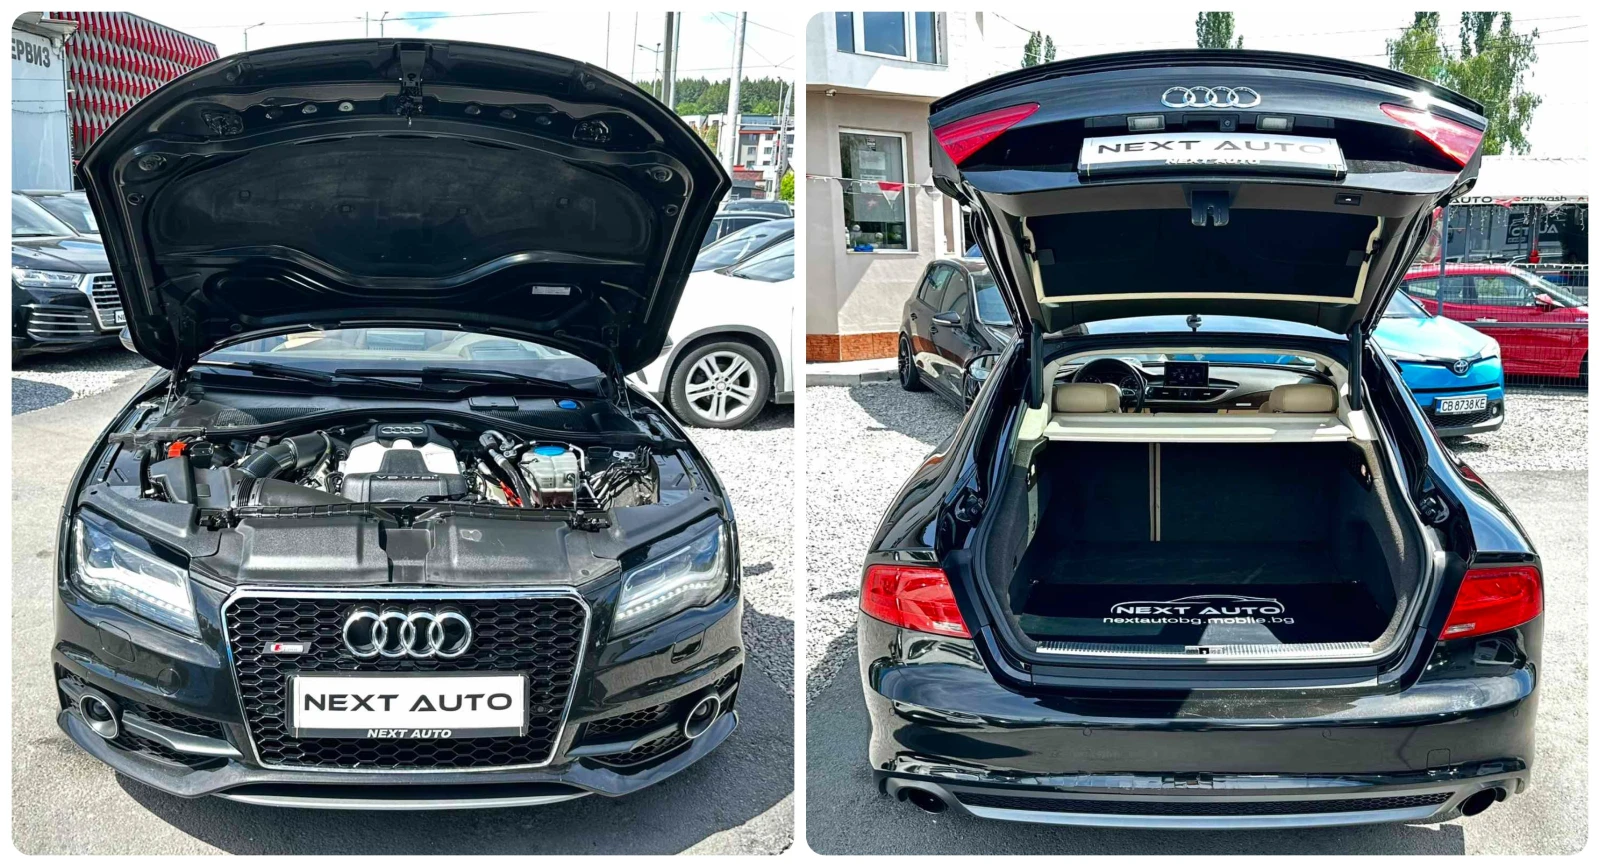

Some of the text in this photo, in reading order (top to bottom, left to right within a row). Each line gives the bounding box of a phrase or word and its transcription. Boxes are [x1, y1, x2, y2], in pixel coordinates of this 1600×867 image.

[1097, 139, 1327, 155] NEXT AUTO
[1450, 196, 1493, 204] AUTO
[1442, 398, 1486, 412] CB 8738 KE
[1116, 606, 1283, 615] NEXT AUTO
[1103, 616, 1295, 625] nextautobg.mobile.bg
[304, 692, 513, 712] NEXT AUTO
[366, 729, 452, 739] NEXT AUTO
